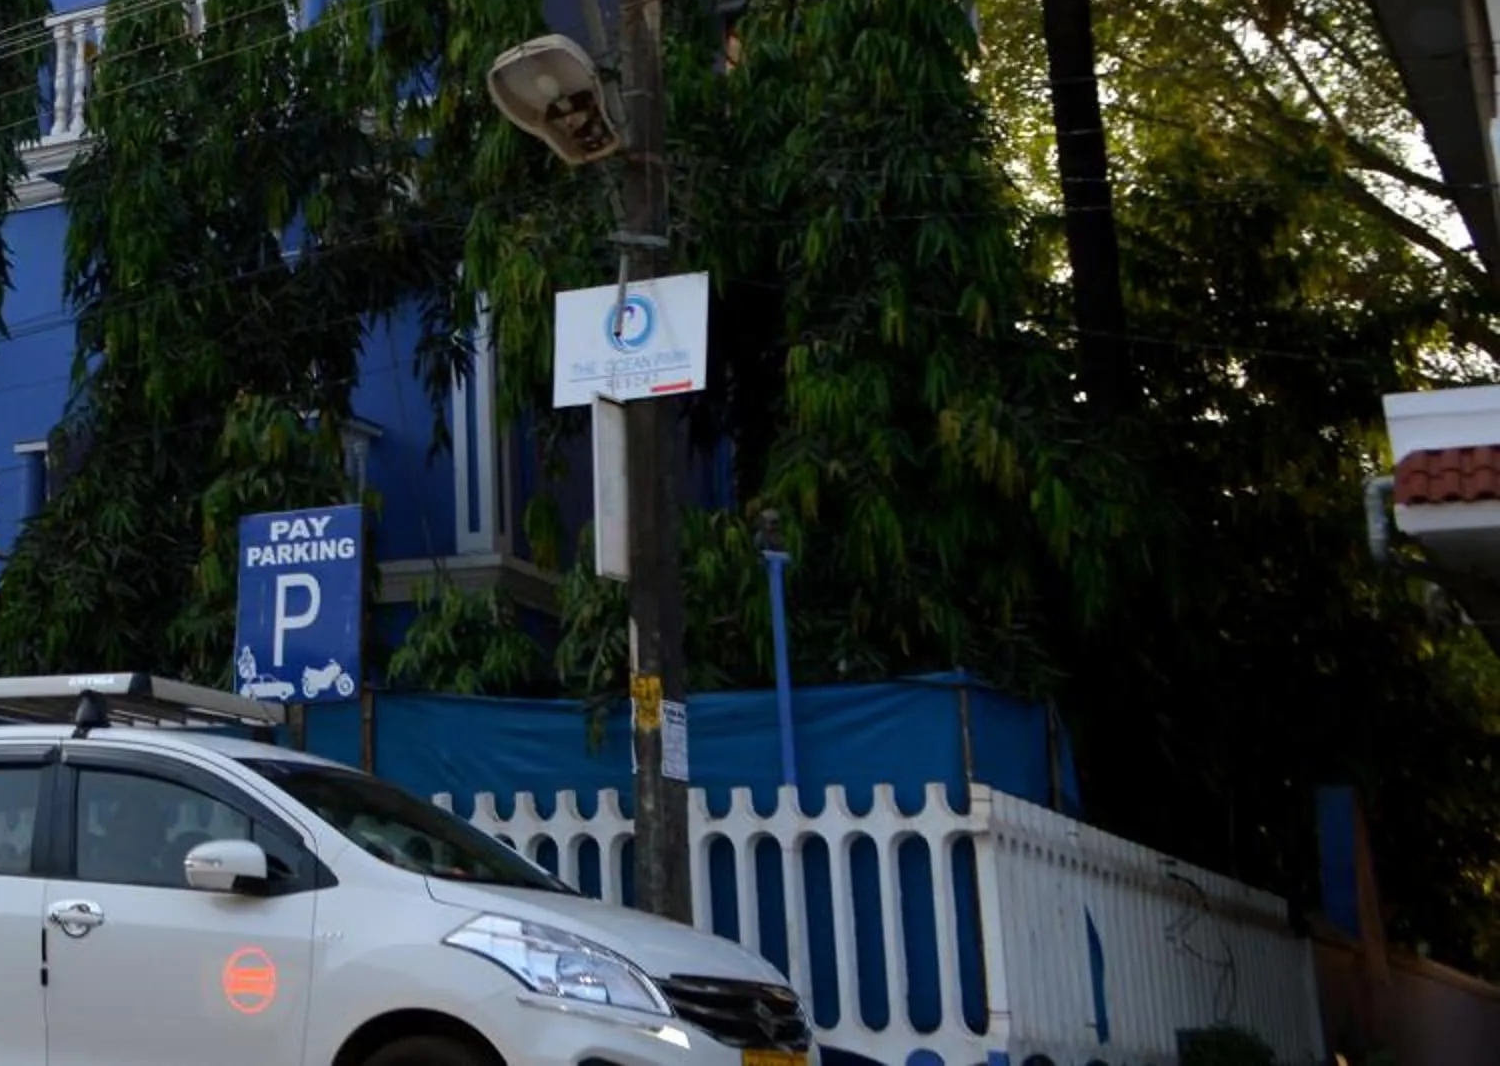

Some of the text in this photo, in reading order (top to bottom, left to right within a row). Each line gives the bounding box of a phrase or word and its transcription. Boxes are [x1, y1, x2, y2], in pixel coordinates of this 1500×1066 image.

[270, 515, 332, 542] PAY
[247, 538, 355, 567] PARKING
[273, 573, 321, 667] P
